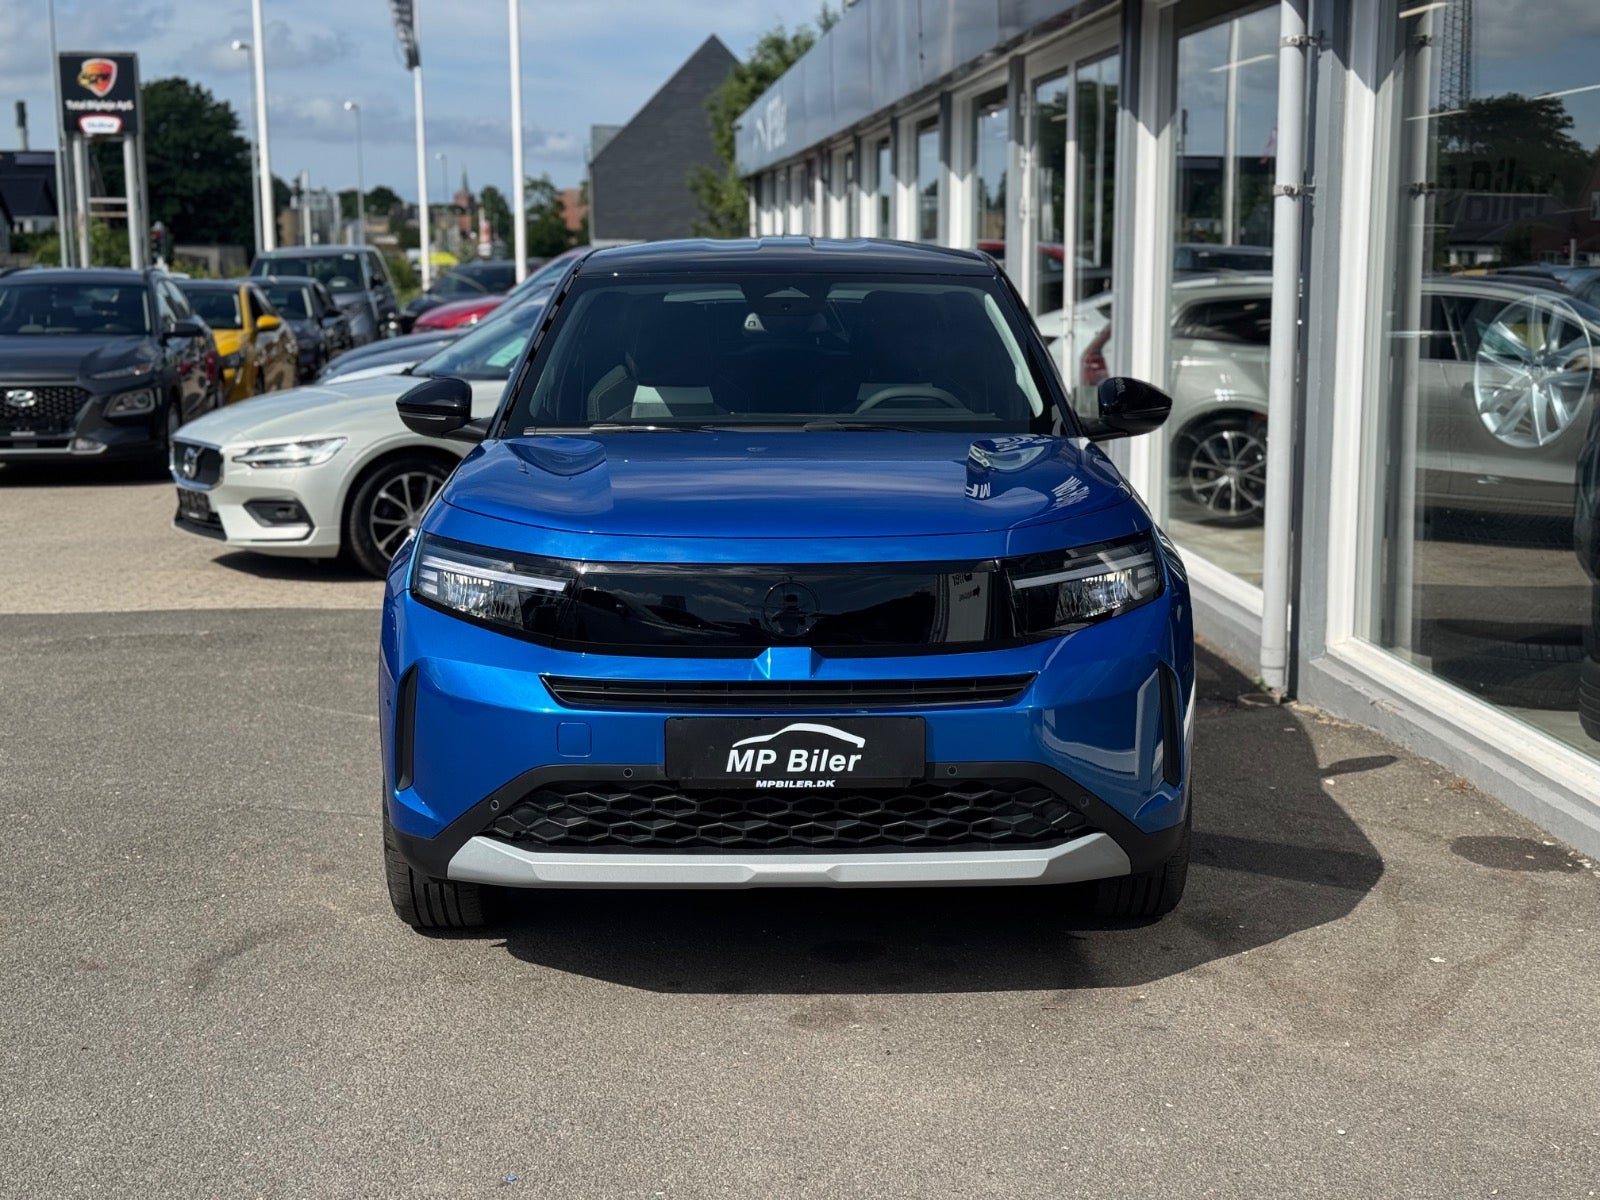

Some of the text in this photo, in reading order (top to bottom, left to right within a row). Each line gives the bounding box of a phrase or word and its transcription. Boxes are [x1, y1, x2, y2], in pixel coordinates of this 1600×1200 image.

[726, 749, 862, 773] MP Biler
[755, 779, 837, 788] MPBILER.DK
